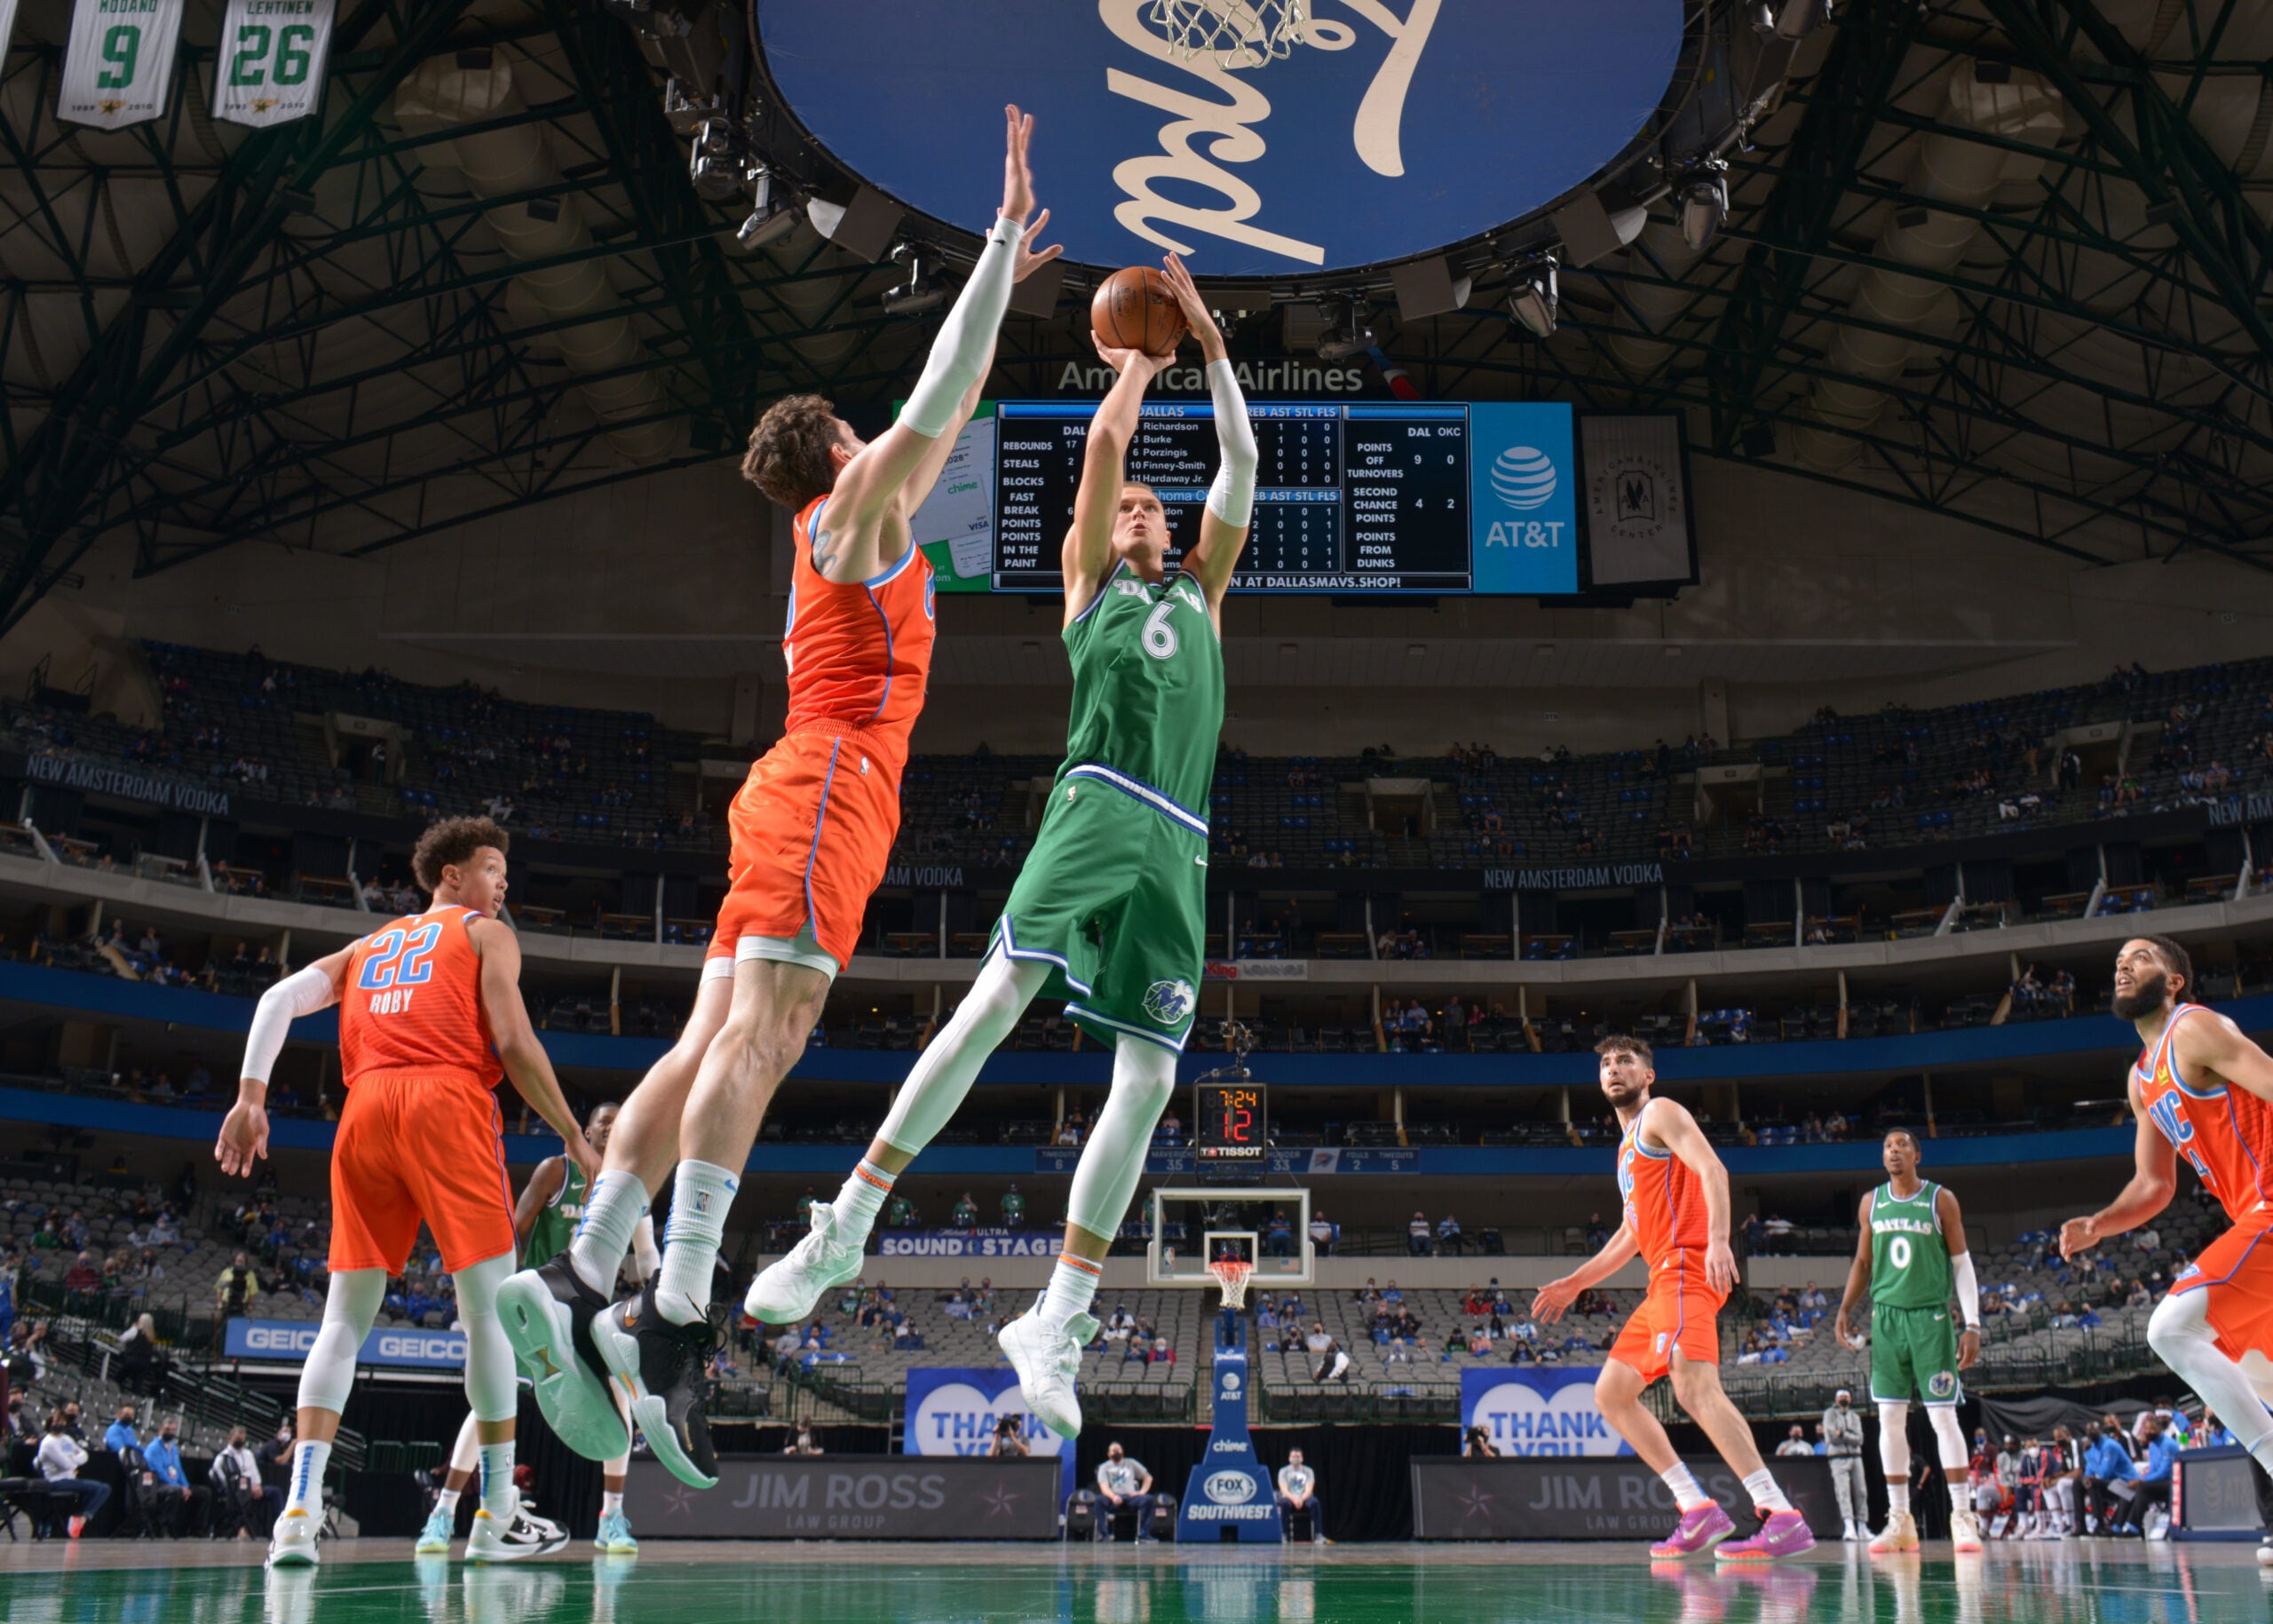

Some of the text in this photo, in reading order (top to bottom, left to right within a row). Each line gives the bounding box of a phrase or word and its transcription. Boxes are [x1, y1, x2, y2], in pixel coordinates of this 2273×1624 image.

[97, 25, 141, 89] 9
[229, 24, 315, 86] 26
[1233, 360, 1363, 392] Airlines
[1270, 408, 1292, 417] AST
[1295, 408, 1314, 417] STL
[1318, 408, 1336, 417] FLS
[1063, 426, 1087, 436] DAL
[1144, 422, 1199, 431] Richardson
[1324, 423, 1330, 432] 0
[1408, 427, 1461, 437] DAL OKC
[1143, 435, 1172, 444] Burke
[1279, 435, 1284, 444] 1
[1302, 435, 1308, 444] 0
[1324, 435, 1330, 444] 0
[1003, 441, 1053, 450] REBOUNDS
[1132, 448, 1331, 458] 6 Porzingis 0 0 1
[1067, 457, 1074, 466] 2
[1366, 455, 1454, 465] OFF 9 0
[1130, 461, 1206, 471] 10 Finney-Smith
[1003, 477, 1044, 487] BLOCKS
[1131, 474, 1204, 485] 11 Hardaway Jr.
[947, 480, 978, 495] chime
[1010, 493, 1034, 502] FAST
[1270, 492, 1292, 501] AST
[1295, 492, 1314, 501] STL
[1318, 492, 1336, 501] FLS
[1353, 499, 1454, 510] CHANCE 4 2
[1255, 507, 1331, 516] 1 1 0 1
[969, 519, 989, 531] VISA
[1002, 519, 1041, 528] POINTS
[1253, 520, 1331, 529] 2 0 0 1
[1002, 533, 1041, 542] POINTS
[1356, 533, 1396, 542] POINTS
[1485, 521, 1564, 548] AT&T
[1019, 545, 1039, 554] THE
[1004, 558, 1037, 567] PAINT
[1246, 577, 1263, 587] AT
[1267, 577, 1400, 588] DALLASMAVS.SHOP!
[1141, 600, 1177, 659] 6
[27, 756, 229, 815] NEW AMSTERDAM VODKA
[2208, 801, 2243, 826] NEW
[915, 867, 963, 886] VODKA
[1484, 863, 1664, 889] NEW AMSTERDAM VODKA
[358, 923, 443, 989] 22
[1208, 962, 1238, 978] King
[368, 988, 414, 1015] ROBY
[1219, 1090, 1256, 1108] 7:24
[1224, 1110, 1251, 1140] 12
[1217, 1147, 1262, 1156] TISSOT
[1055, 1159, 1064, 1170] 6
[1166, 1159, 1184, 1170] 35
[1273, 1161, 1290, 1170] 33
[1353, 1161, 1399, 1170] 2 5
[1873, 1218, 1932, 1235] DALLAS
[883, 1239, 1064, 1256] SOUND STAGE
[1889, 1236, 1912, 1269] 0
[246, 1328, 317, 1351] GEIC
[379, 1336, 467, 1359] GEICO
[1220, 1391, 1241, 1400] AT&T
[1488, 1412, 1608, 1438] THANK
[1213, 1439, 1247, 1452] chime
[1216, 1479, 1243, 1491] FOX
[733, 1474, 946, 1509] JIM ROSS
[1529, 1475, 1602, 1509] JIM
[1188, 1505, 1272, 1519] SOUTHWEST
[787, 1515, 886, 1529] LAW GROUP
[1587, 1517, 1621, 1530] LAW
